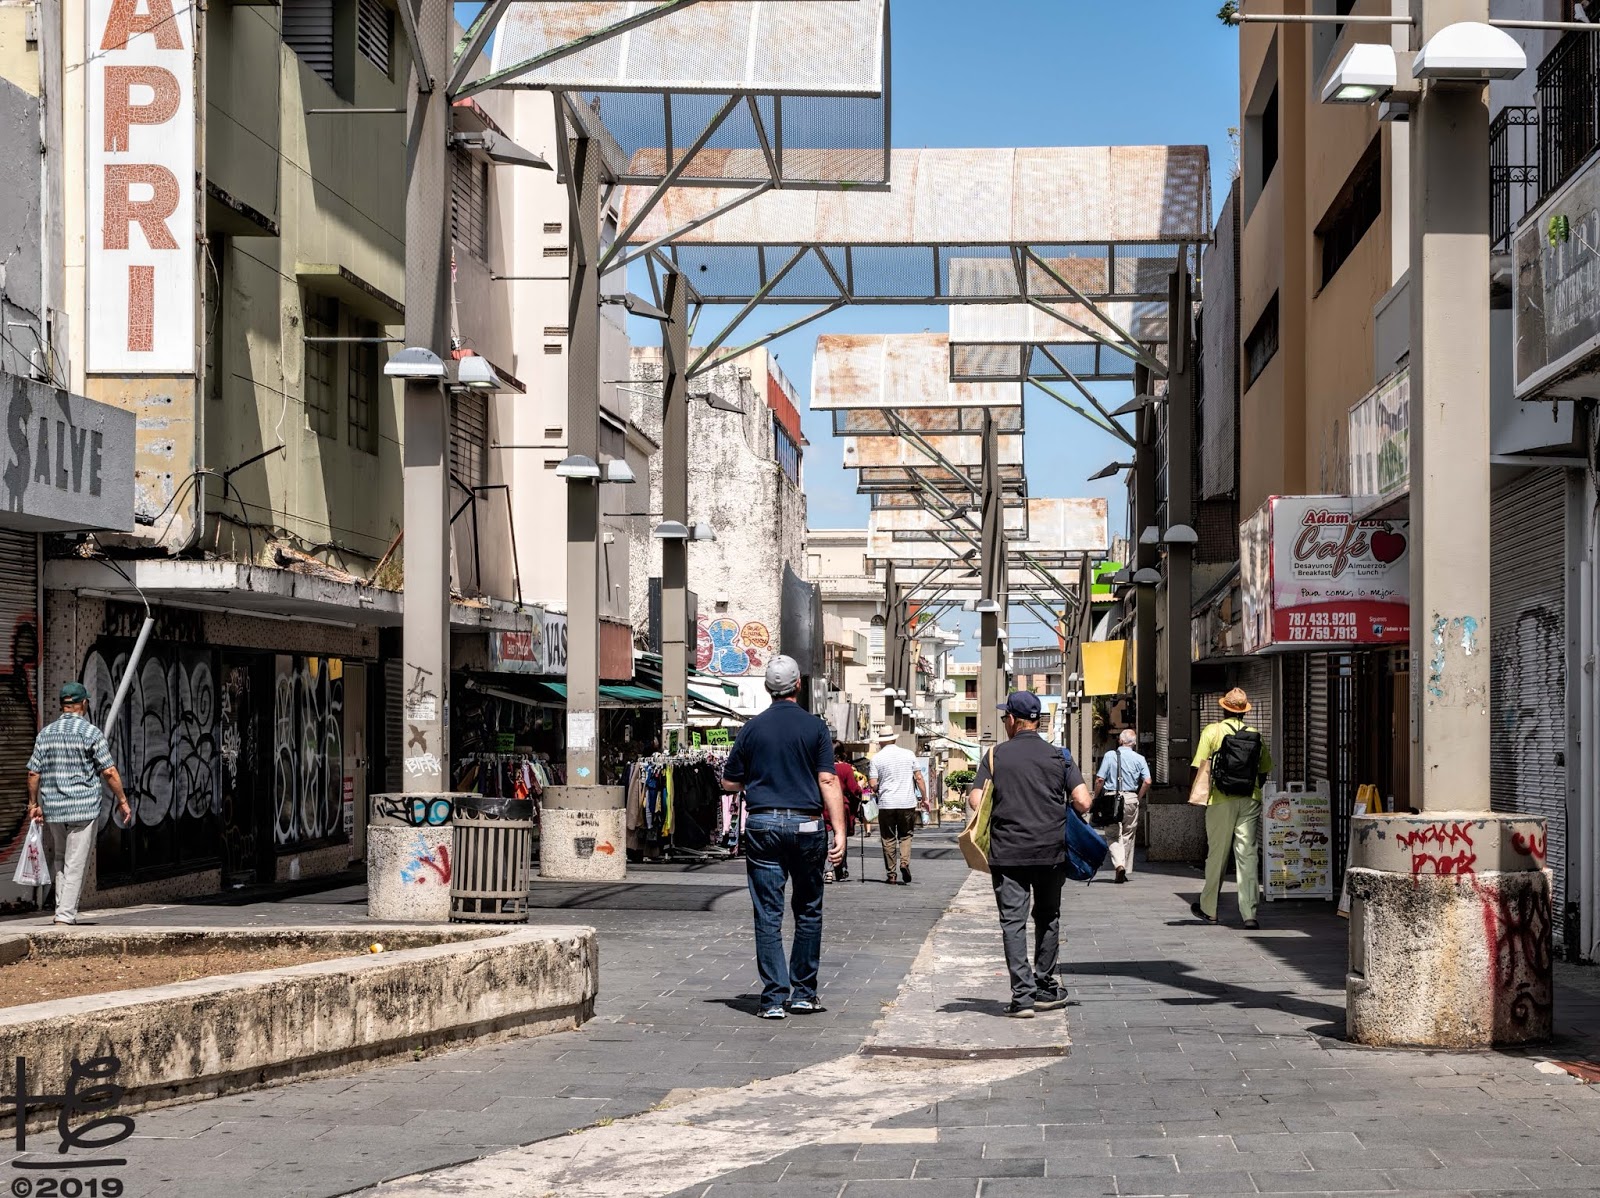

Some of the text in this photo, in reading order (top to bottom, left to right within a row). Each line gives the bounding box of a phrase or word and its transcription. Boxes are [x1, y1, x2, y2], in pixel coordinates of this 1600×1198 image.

[1304, 511, 1350, 525] Adam
[1294, 523, 1370, 578] Café
[1294, 563, 1333, 571] Desayunos
[1301, 588, 1321, 597] Para
[1325, 589, 1354, 598] comer,
[1358, 588, 1366, 596] lo
[1288, 612, 1357, 626] 787.433.9210
[1288, 626, 1358, 640] 787.759.7913
